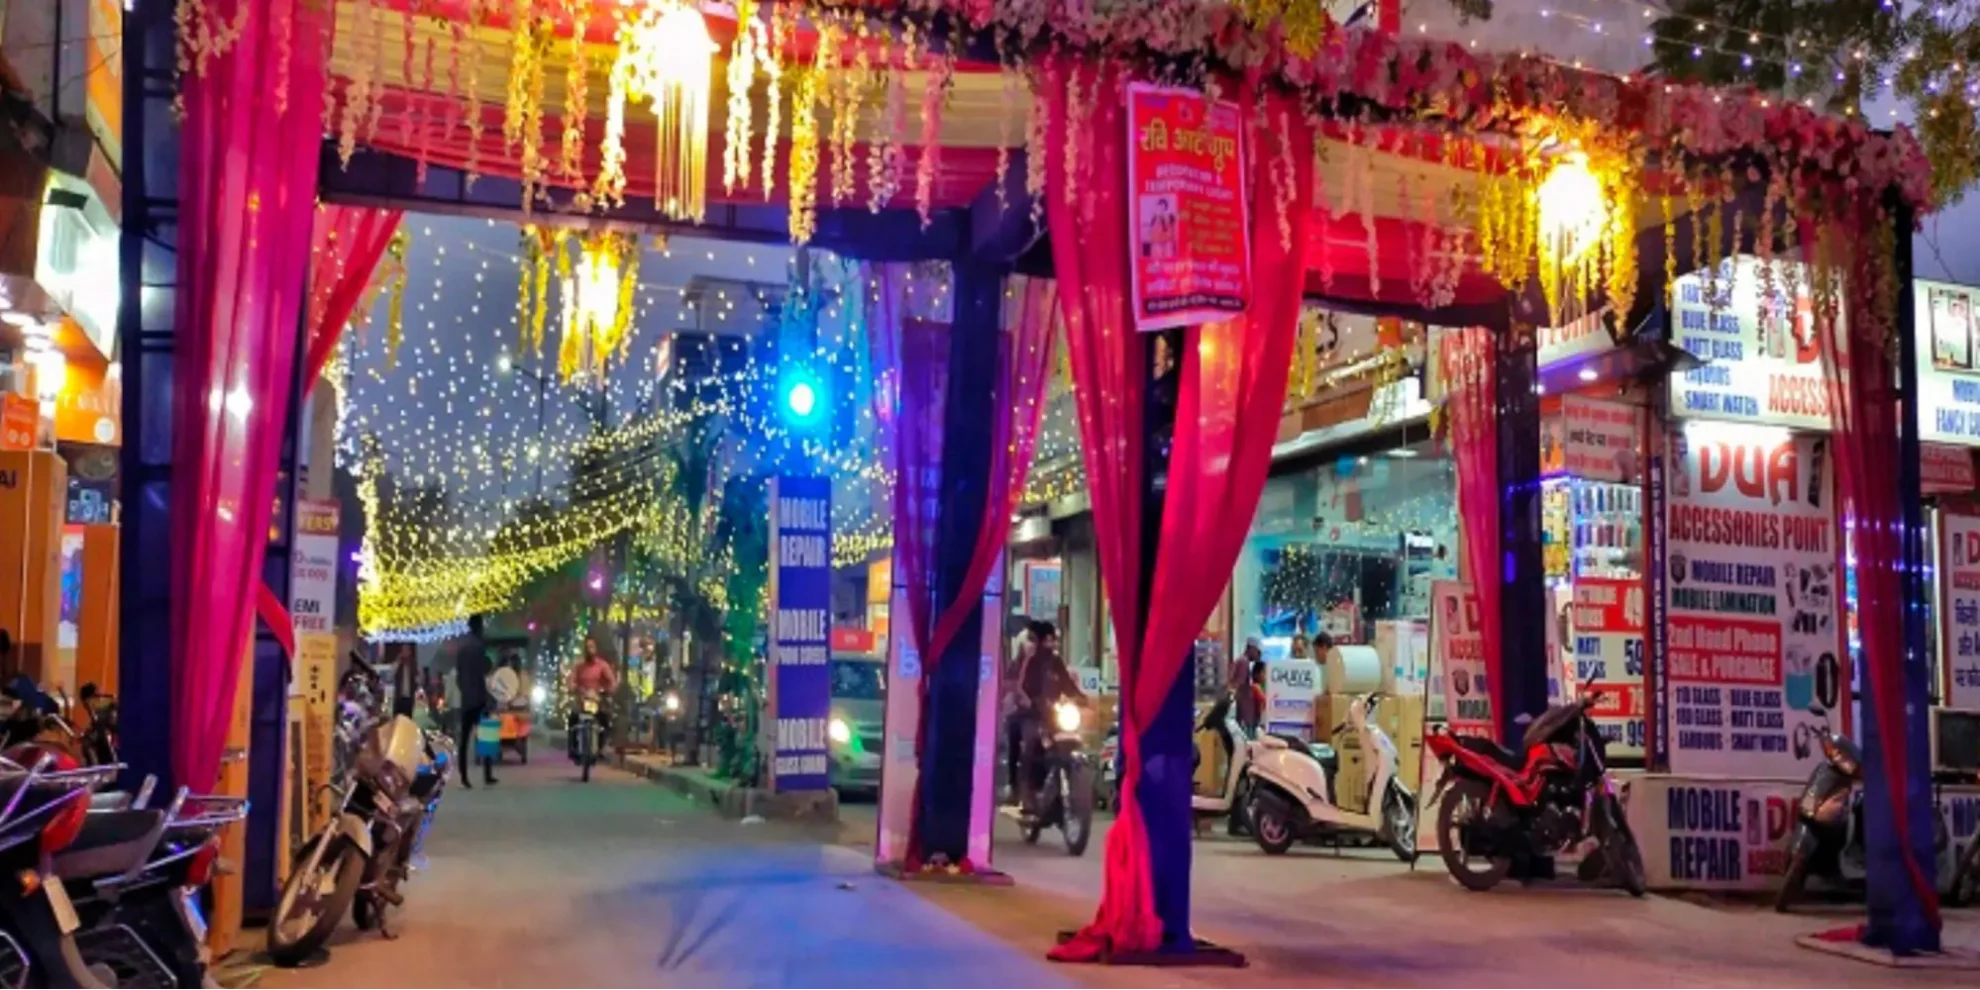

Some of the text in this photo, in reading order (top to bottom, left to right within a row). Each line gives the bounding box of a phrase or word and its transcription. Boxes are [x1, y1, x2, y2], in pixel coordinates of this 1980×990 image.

[1699, 440, 1798, 505] DUA
[780, 497, 828, 529] MOBILE
[1669, 503, 1829, 552] ACCESSORIES POINT
[780, 534, 827, 567] REPAIR
[1692, 559, 1734, 584] MOBILE
[294, 599, 320, 613] EMI
[779, 608, 827, 640] MOBILE
[777, 717, 827, 750] MOBILE
[1668, 786, 1741, 832] MOBILE
[1670, 837, 1740, 880] REPAIR
